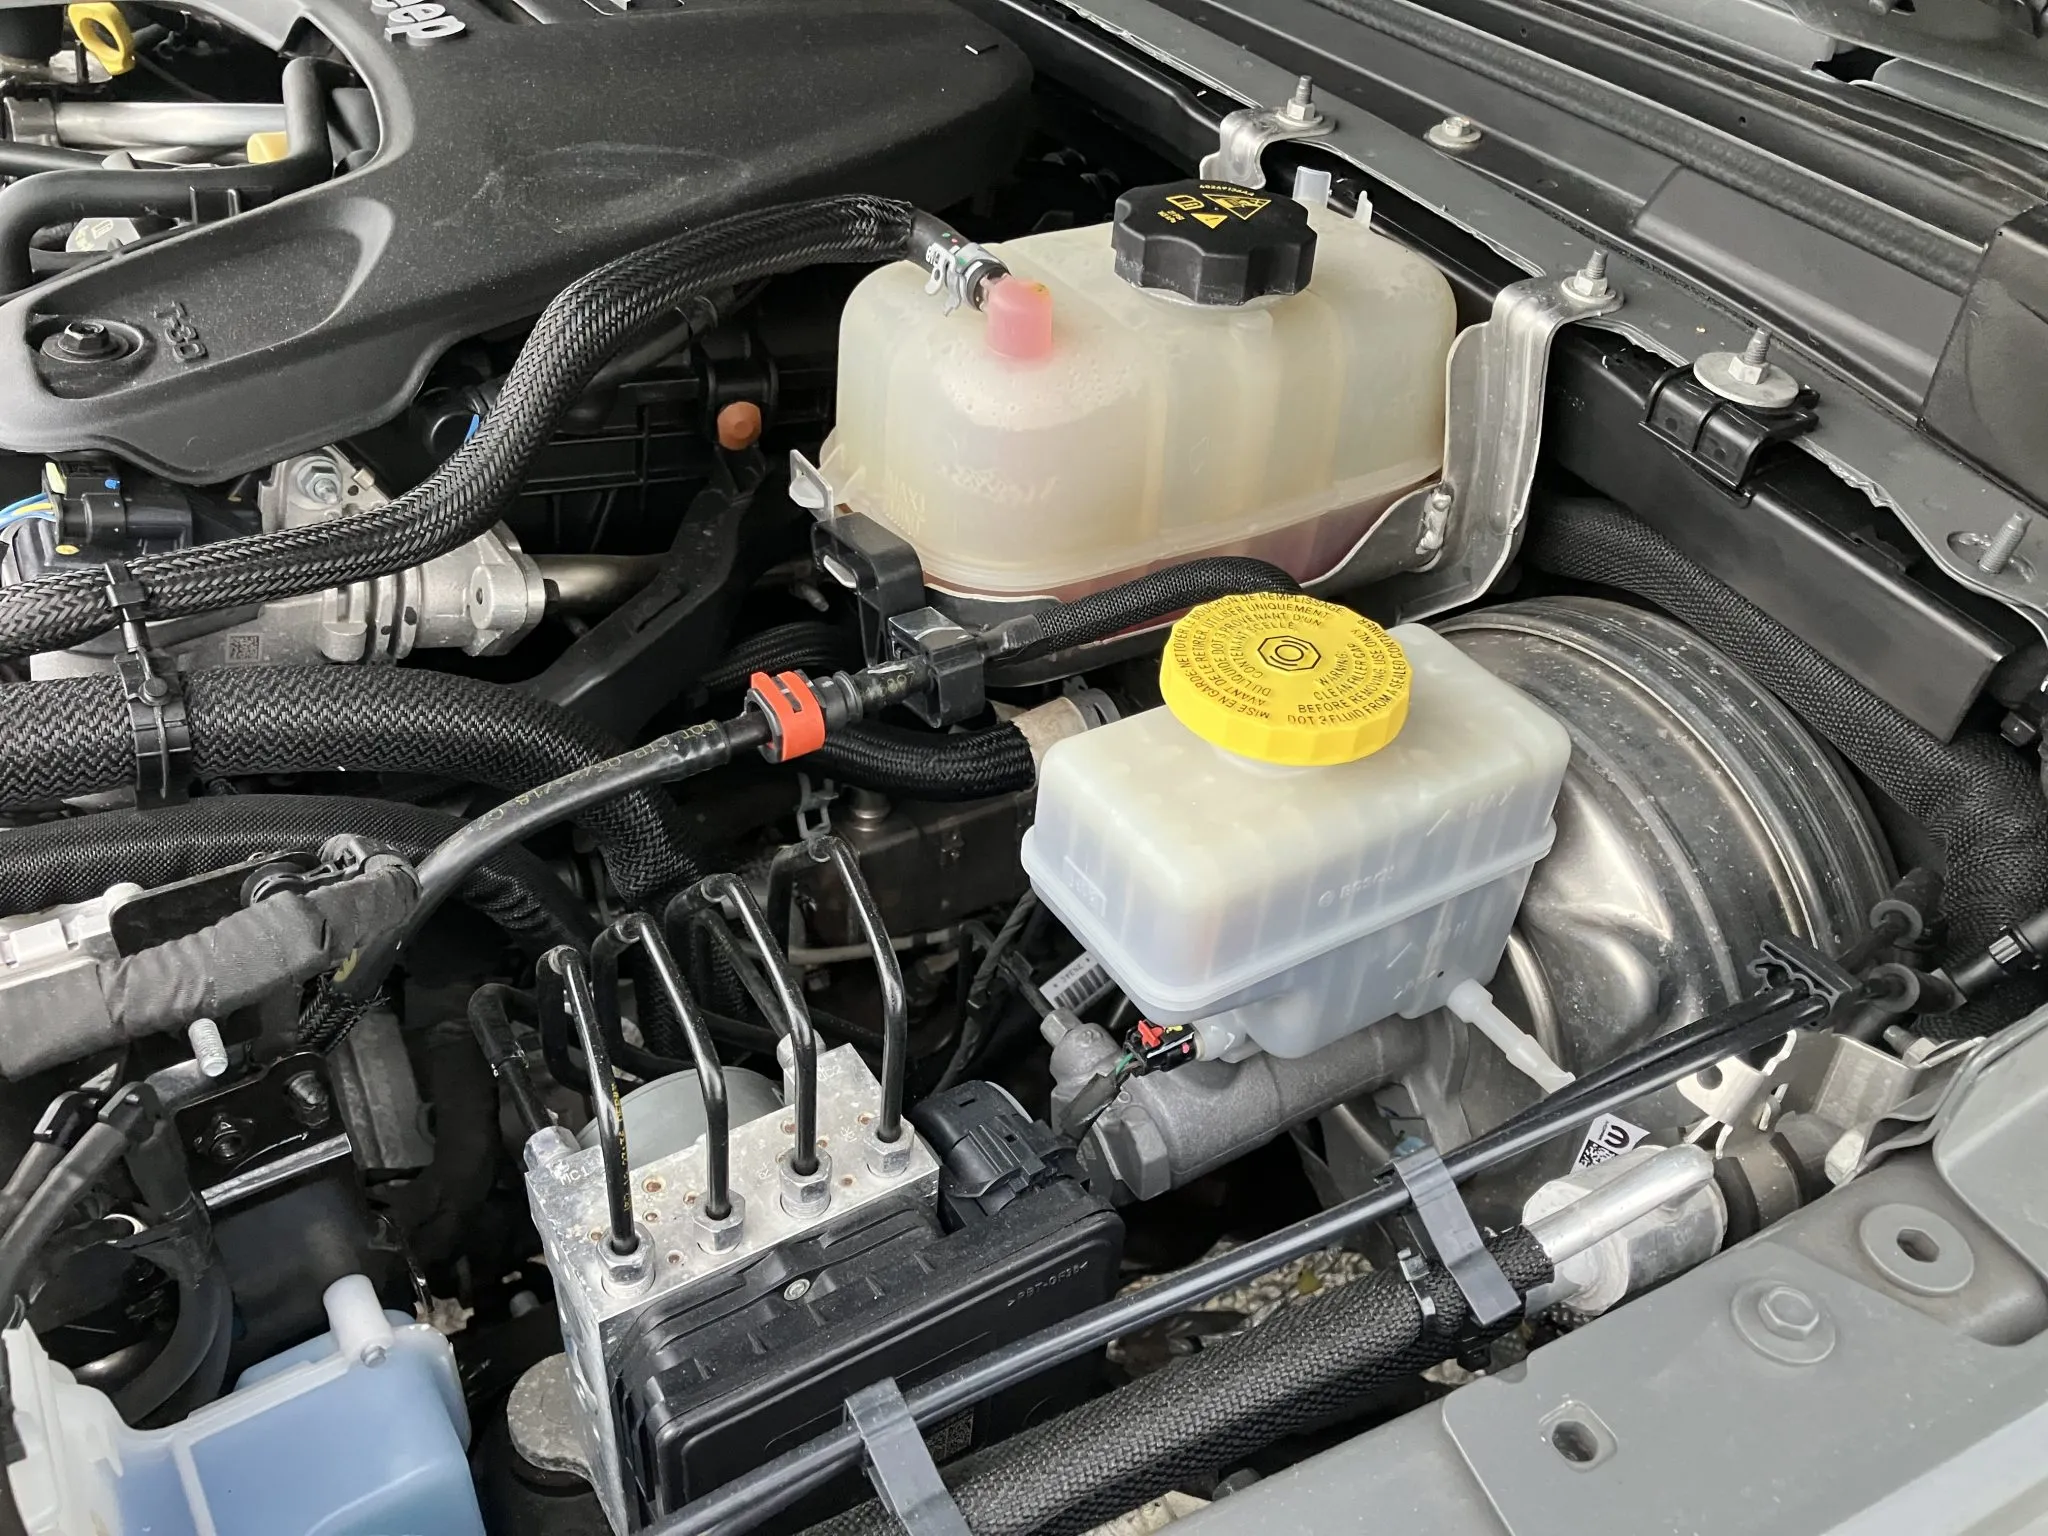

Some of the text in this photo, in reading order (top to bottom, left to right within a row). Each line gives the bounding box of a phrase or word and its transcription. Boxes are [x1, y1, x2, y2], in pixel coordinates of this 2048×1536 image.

[153, 300, 210, 364] T-30
[1240, 593, 1256, 602] DE
[1259, 591, 1345, 614] REMPLISSAGE
[1203, 606, 1246, 630] UTILISER
[1247, 602, 1332, 620] UNIQUEMENT
[1292, 613, 1323, 627] D'UN
[1221, 612, 1287, 638] PROVENANT
[1210, 639, 1224, 655] DOT
[1350, 628, 1378, 648] ONLY
[1173, 629, 1191, 669] NETTOYER
[1228, 630, 1265, 679] CONTENANT
[1370, 649, 1387, 666] USE
[1198, 664, 1212, 675] LE
[1214, 657, 1253, 689] LIQUIDE
[1287, 618, 1407, 726] DOT 3 FLUID FROM A SEALED CONTAINER
[1313, 642, 1368, 702] CLEAN FILLER CAP
[1209, 675, 1228, 687] DE
[1225, 687, 1266, 706] AVANT
[1252, 685, 1273, 698] DU
[1219, 695, 1237, 708] EN
[1298, 698, 1351, 714] BEFORE
[1237, 703, 1270, 719] MISE
